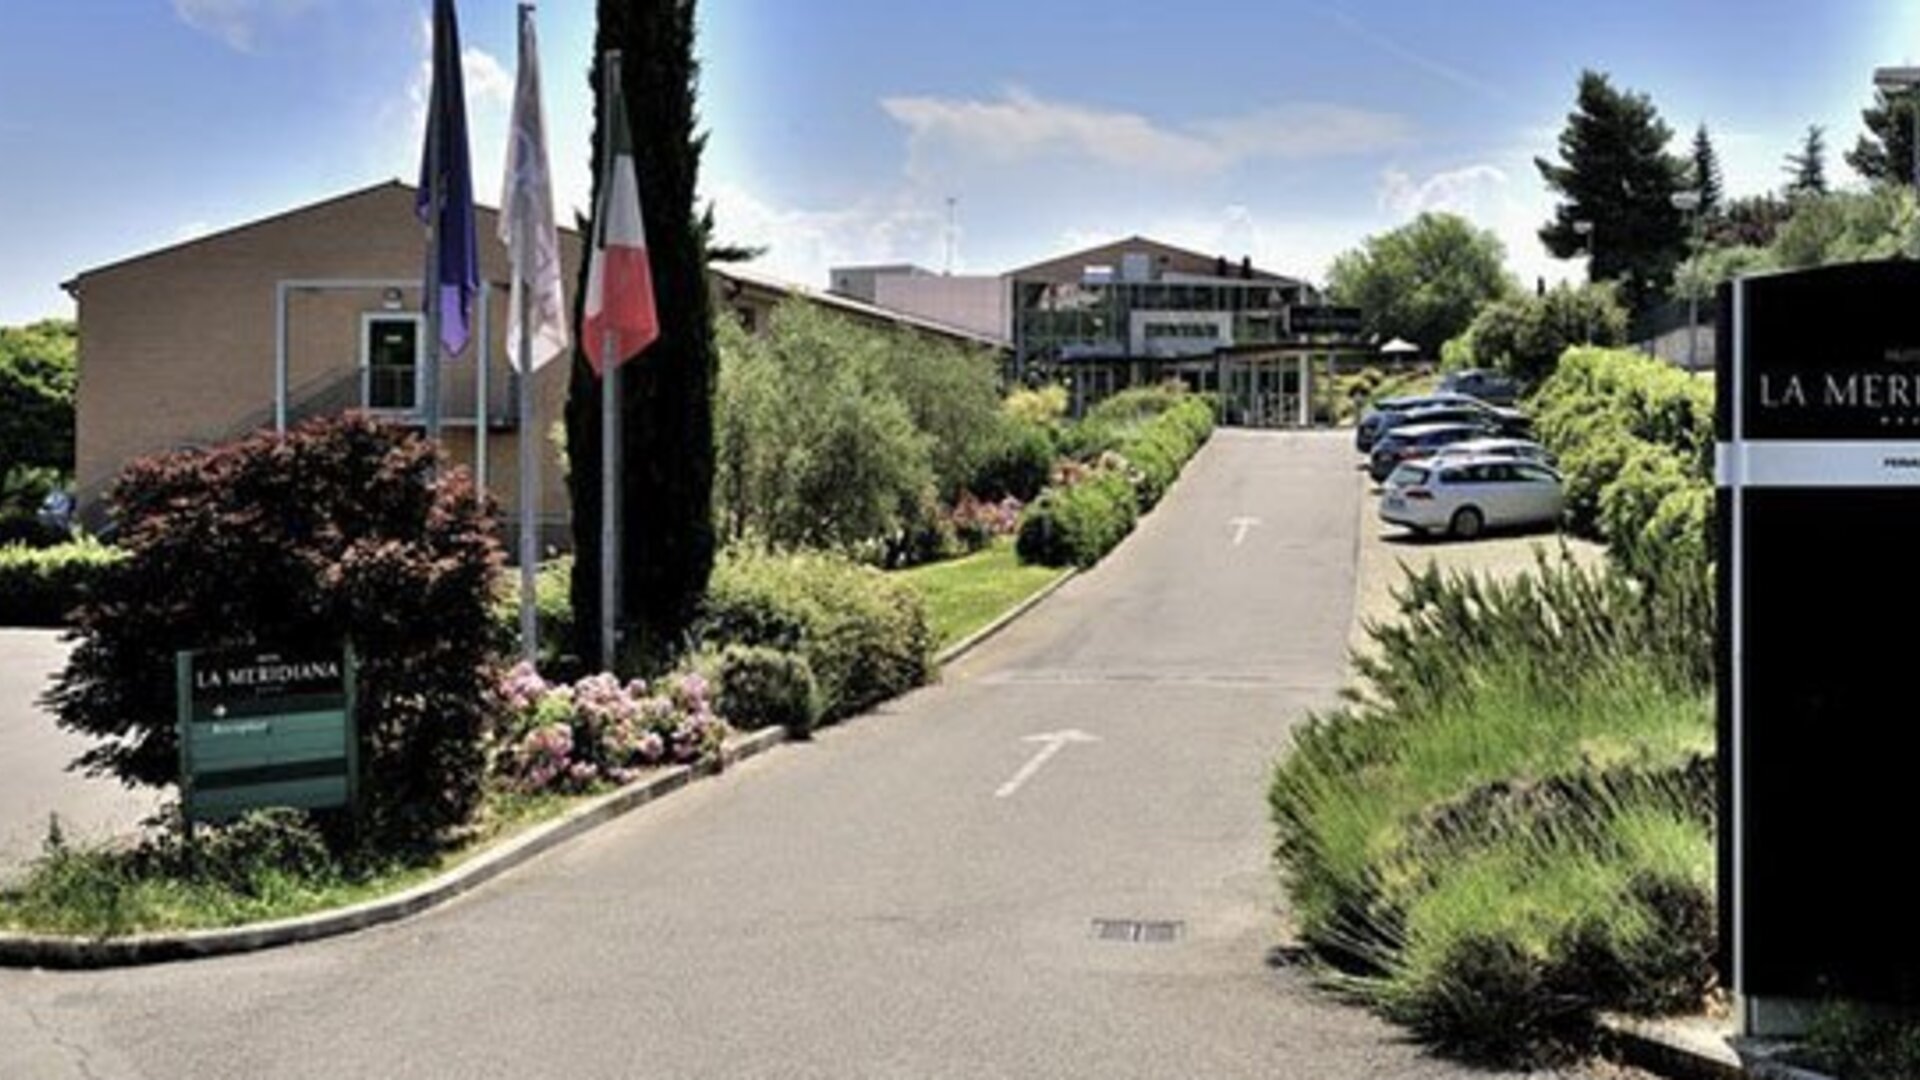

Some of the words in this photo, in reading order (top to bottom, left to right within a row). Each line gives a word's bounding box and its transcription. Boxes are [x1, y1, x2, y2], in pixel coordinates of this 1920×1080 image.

[1760, 374, 1806, 407] LA
[197, 670, 221, 688] LA
[228, 662, 338, 685] MERIDIANA
